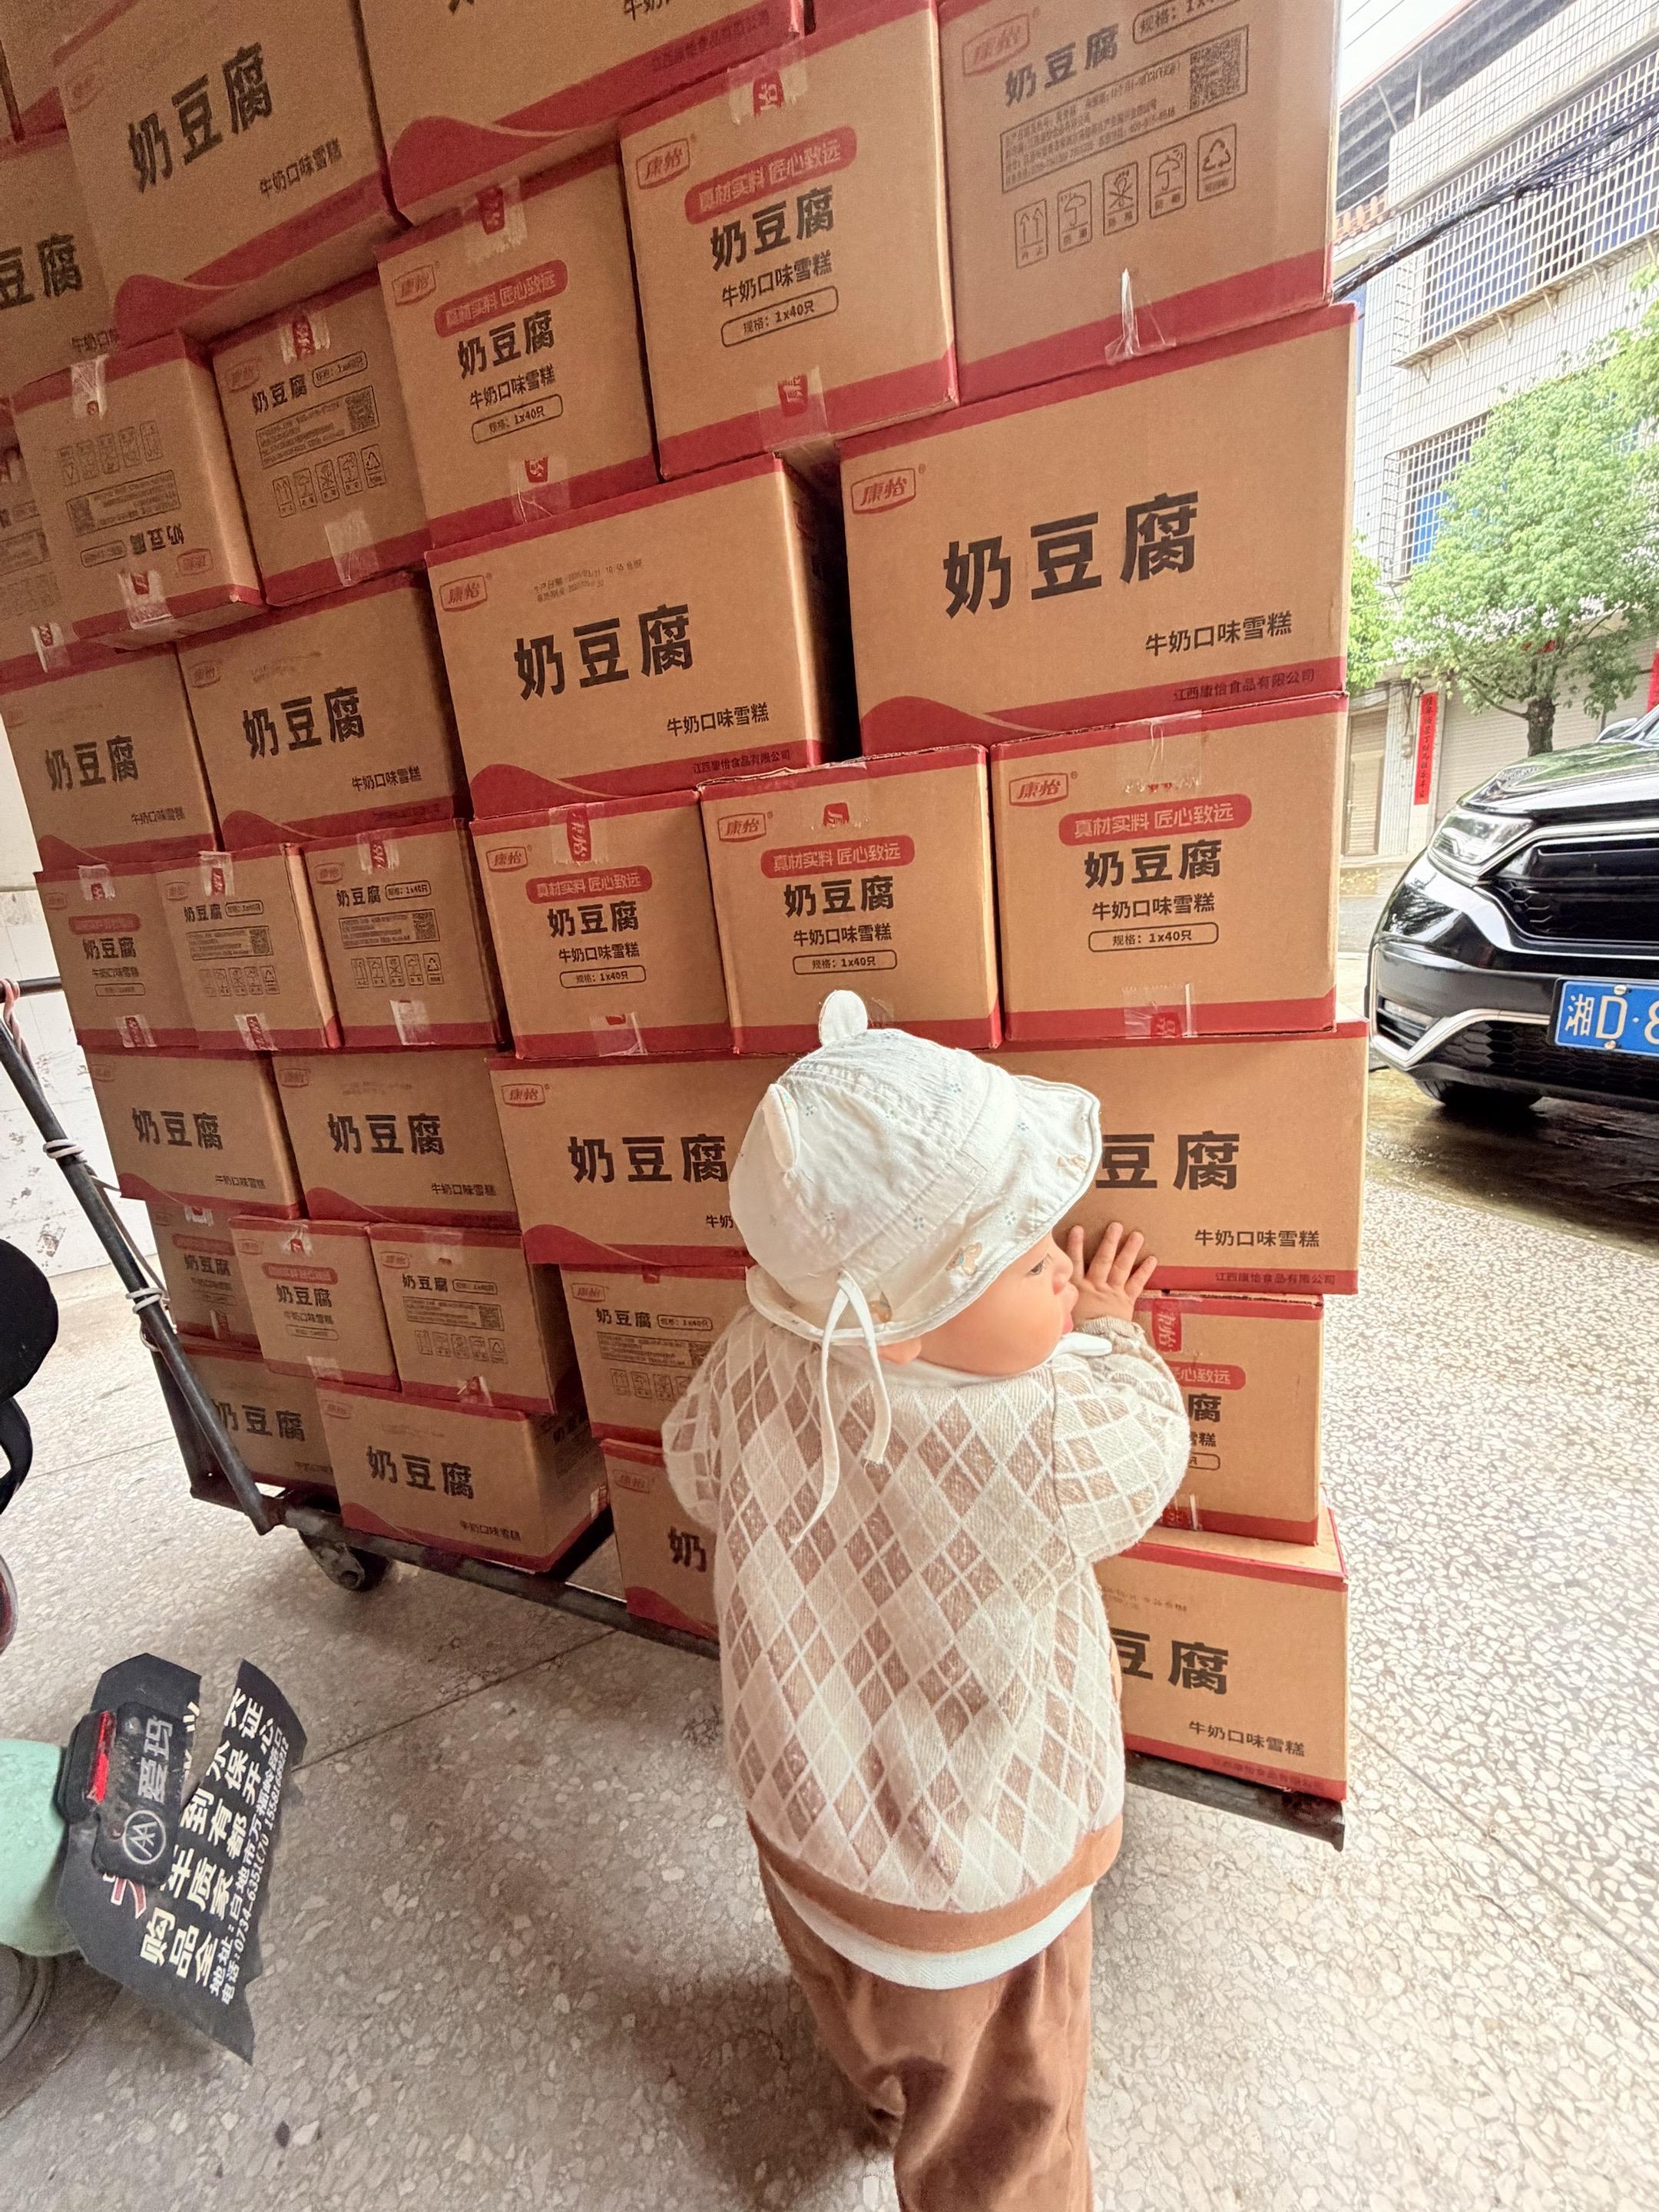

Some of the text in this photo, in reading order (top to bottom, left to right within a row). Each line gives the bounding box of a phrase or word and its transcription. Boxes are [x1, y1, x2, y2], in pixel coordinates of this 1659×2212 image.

[1005, 23, 1119, 108] 奶豆腐
[127, 41, 273, 194] 奶豆腐
[710, 185, 835, 272] 奶豆腐
[721, 250, 833, 308] 牛奶口味雪糕
[457, 309, 555, 380] 奶豆腐
[252, 374, 307, 415] 奶豆腐
[469, 363, 557, 410] 牛奶口味雪糕
[859, 476, 909, 507] 康怡
[942, 491, 1199, 619] 奶豆腐
[514, 604, 694, 700] 奶豆腐
[1144, 611, 1293, 657] 牛奶口味雪糕
[242, 685, 366, 760] 奶豆腐
[666, 702, 770, 737] 牛奶口味雪糕
[44, 735, 139, 792] 奶豆腐
[1017, 779, 1061, 800] 康怡
[725, 818, 760, 836] 康怡
[1075, 803, 1234, 838] 真材实料 匠心致远
[773, 843, 901, 872] 真材实料 匠心致远
[1084, 839, 1223, 889] 奶豆腐
[336, 885, 382, 908] 奶豆腐
[783, 875, 894, 919] 奶豆腐
[1091, 892, 1216, 921] 牛奶口味雪糕
[547, 900, 639, 939] 奶豆腐
[793, 922, 893, 947] 牛奶口味雪糕
[82, 937, 137, 960] 奶豆腐
[558, 942, 640, 964] 牛奶口味雪糕
[131, 1108, 224, 1150] 奶豆腐
[327, 1113, 445, 1155] 奶豆腐
[568, 1133, 728, 1184] 奶豆腐
[1194, 1230, 1320, 1247] 牛奶口味雪糕
[276, 1283, 333, 1308] 奶豆腐
[402, 1273, 448, 1292] 奶豆腐
[596, 1307, 651, 1329] 奶豆腐
[366, 1445, 474, 1500] 奶豆腐
[1189, 1720, 1306, 1757] 牛奶口味雪糕
[138, 1716, 173, 1804] 爱玛
[169, 1697, 263, 1979] 品质有保证
[196, 1718, 273, 1987] 全家都开心
